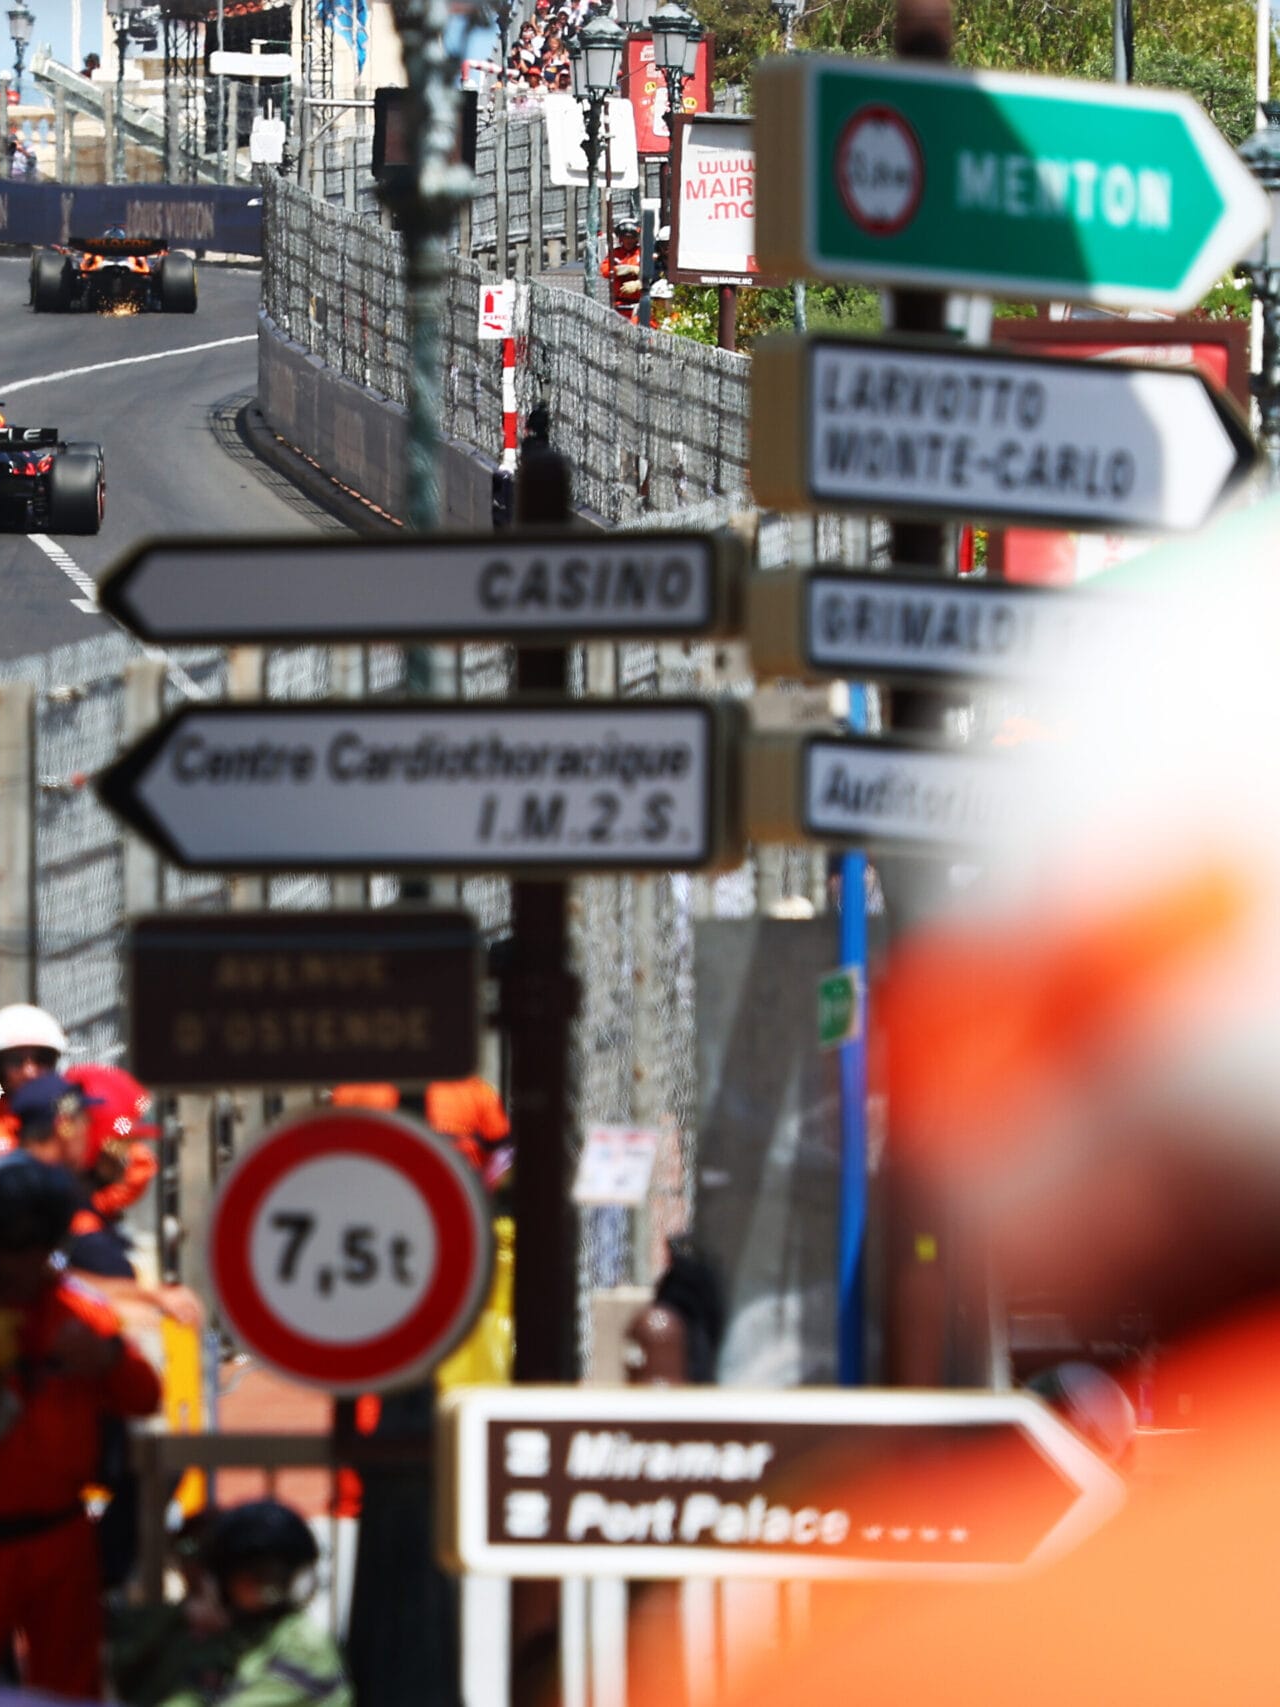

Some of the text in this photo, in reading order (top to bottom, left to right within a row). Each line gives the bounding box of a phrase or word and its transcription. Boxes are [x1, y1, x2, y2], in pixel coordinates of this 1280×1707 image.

[685, 176, 755, 201] MAIR
[956, 149, 1173, 230] MENTON
[823, 362, 1046, 429] LARVOTTO
[824, 427, 1137, 498] MONTE-CARLO
[475, 557, 694, 613] CASINO
[170, 729, 692, 790] Centre Cardiothoracique
[475, 791, 693, 844] I.M.2.S.
[565, 1429, 774, 1482] Miramar
[565, 1490, 851, 1546] Port Palace
